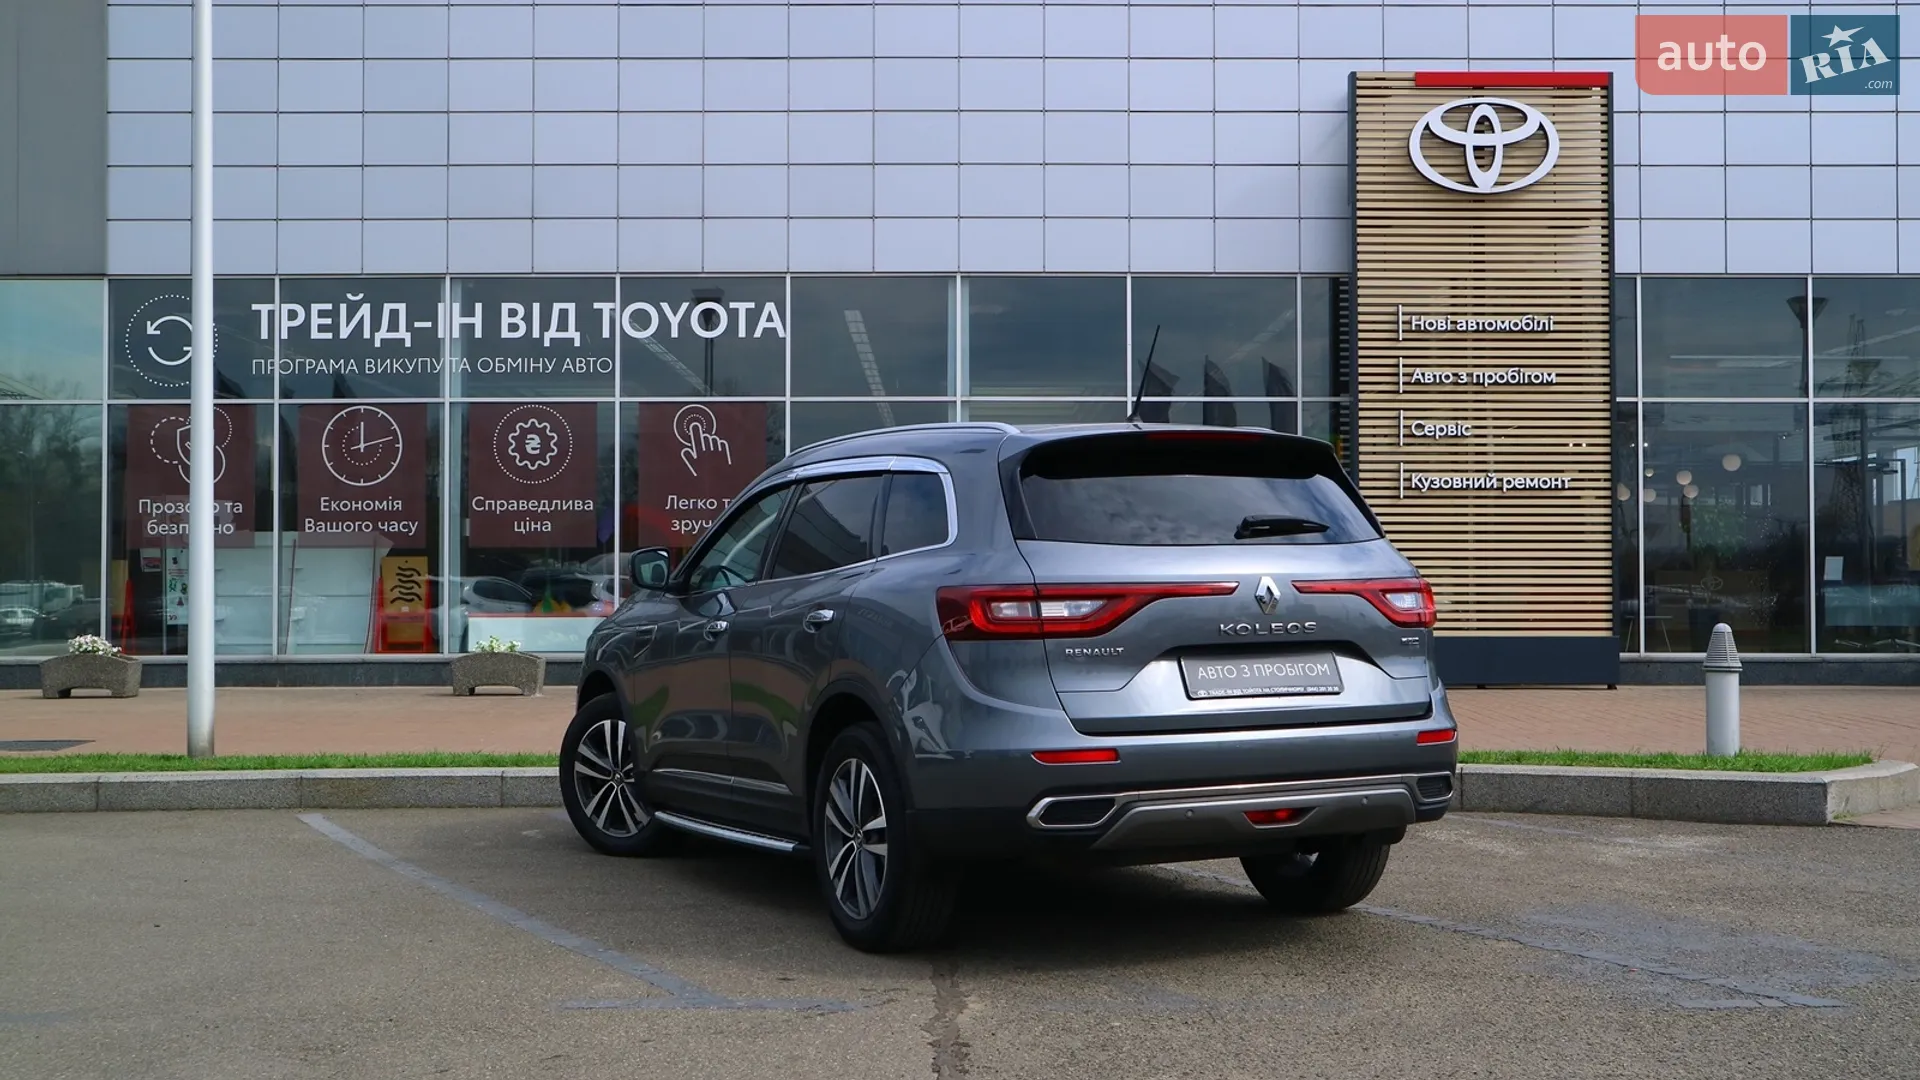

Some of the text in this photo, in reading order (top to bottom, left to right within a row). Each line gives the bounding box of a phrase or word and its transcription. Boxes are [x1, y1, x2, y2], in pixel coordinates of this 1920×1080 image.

[251, 293, 786, 348] ТРЕЙД-ІН ВІД TOYOTA
[1411, 315, 1554, 332] Нові автомобілі
[252, 357, 613, 375] ПРОГРАМА ВИКУПУ ТА ОБМІНУ АВТО
[1411, 367, 1557, 388] Авто з пробігом
[1411, 420, 1472, 440] Сервіс
[1411, 473, 1571, 492] Кузовний ремонт
[224, 502, 243, 514] та
[320, 497, 402, 512] Економія
[471, 496, 594, 513] Справедлива
[665, 495, 718, 510] Легко
[147, 519, 234, 535] безпно
[305, 519, 418, 536] Вашого часу
[514, 517, 551, 533] ціна
[1219, 622, 1317, 635] KOLEOS
[1065, 647, 1124, 657] RENAULT
[1198, 665, 1237, 680] АВТО
[1253, 663, 1331, 677] ПРОБІГОМ
